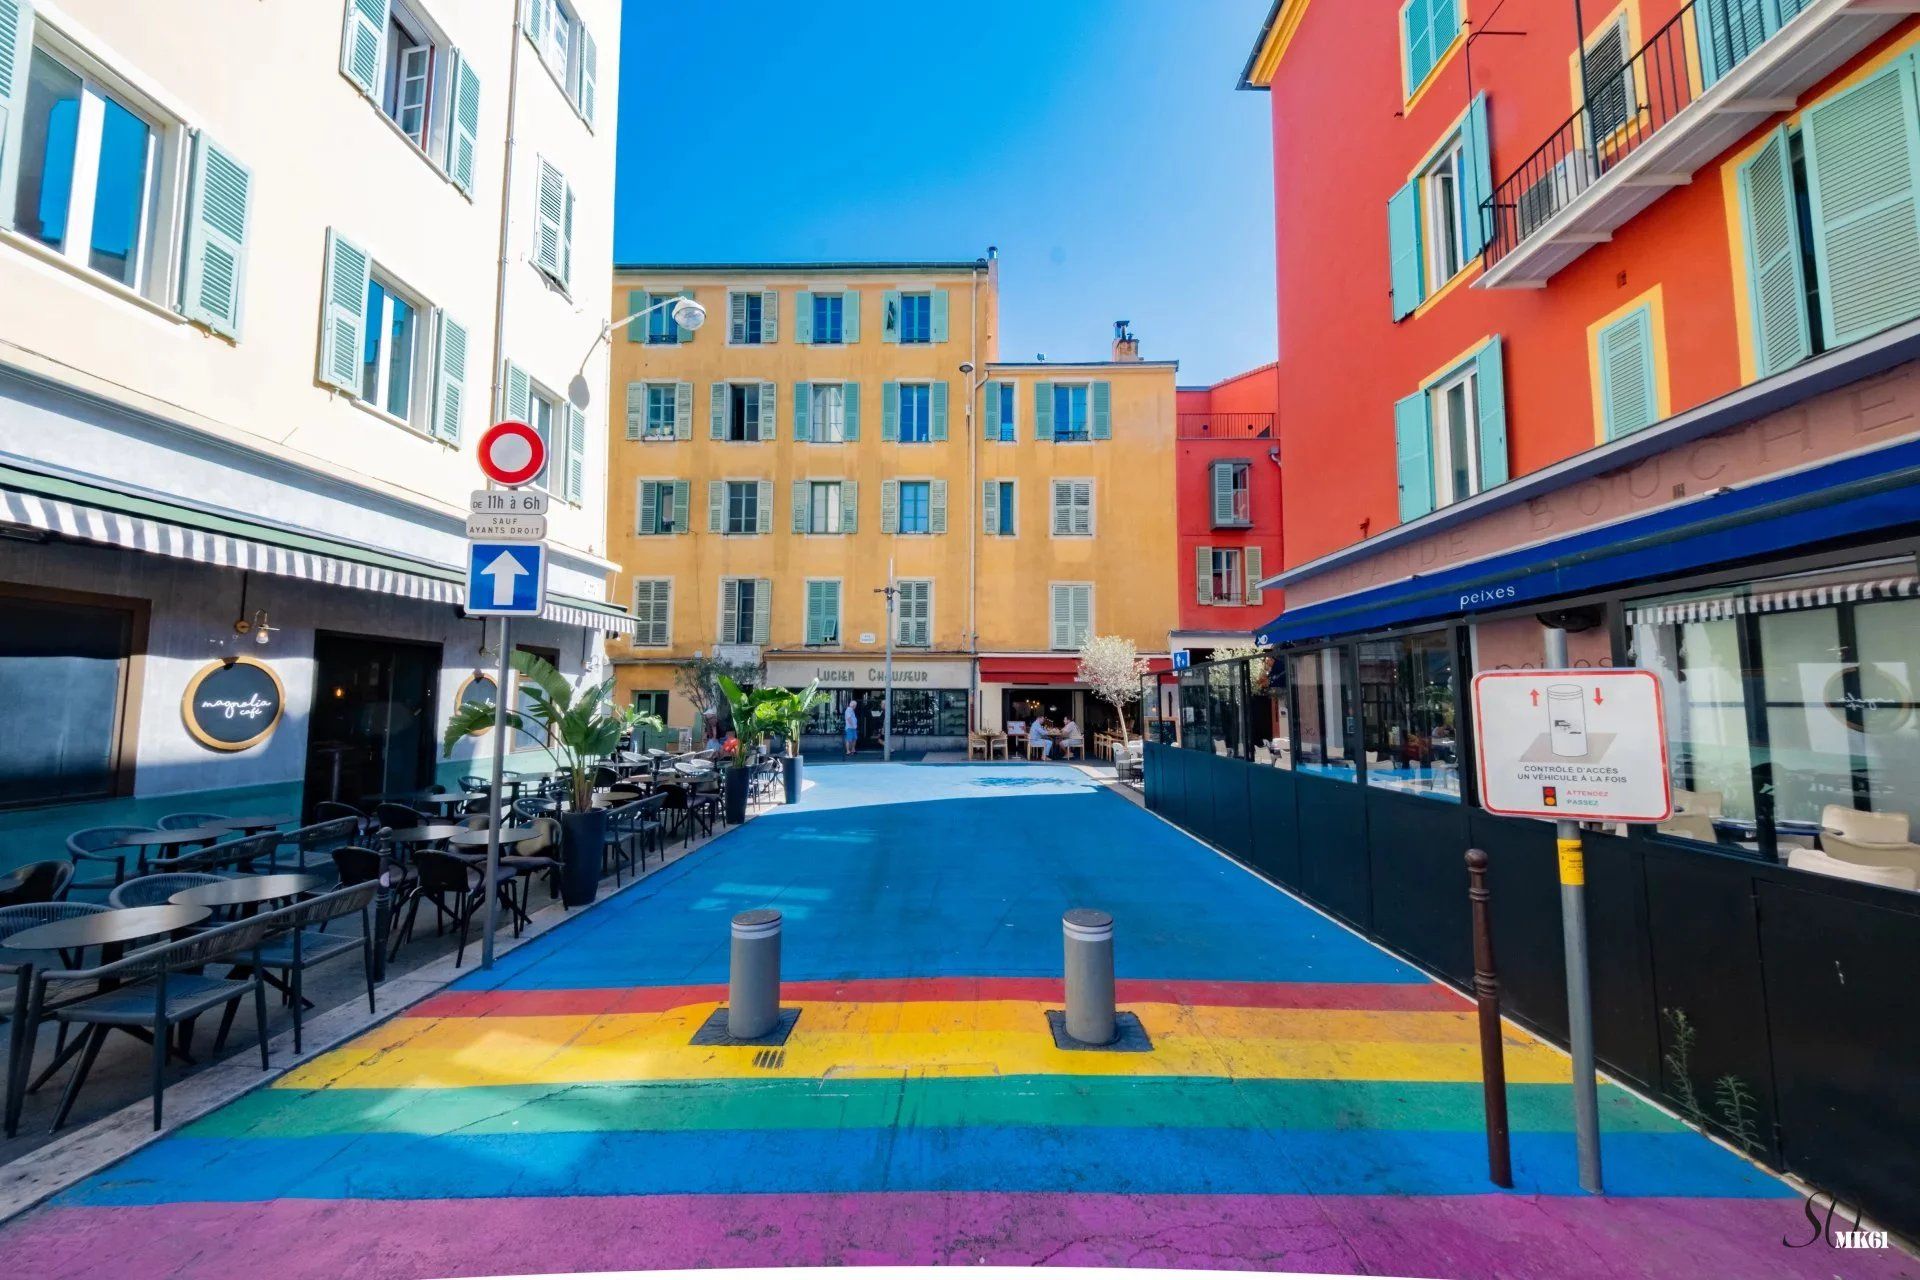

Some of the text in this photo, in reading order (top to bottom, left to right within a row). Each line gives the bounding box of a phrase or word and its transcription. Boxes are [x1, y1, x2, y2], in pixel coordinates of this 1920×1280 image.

[472, 495, 540, 510] DE 11h à 6h
[492, 517, 518, 525] SAUF
[469, 526, 540, 535] AYANTS DROIT
[1460, 585, 1515, 611] peixes
[201, 692, 272, 719] magnolia
[1590, 775, 1603, 783] LA
